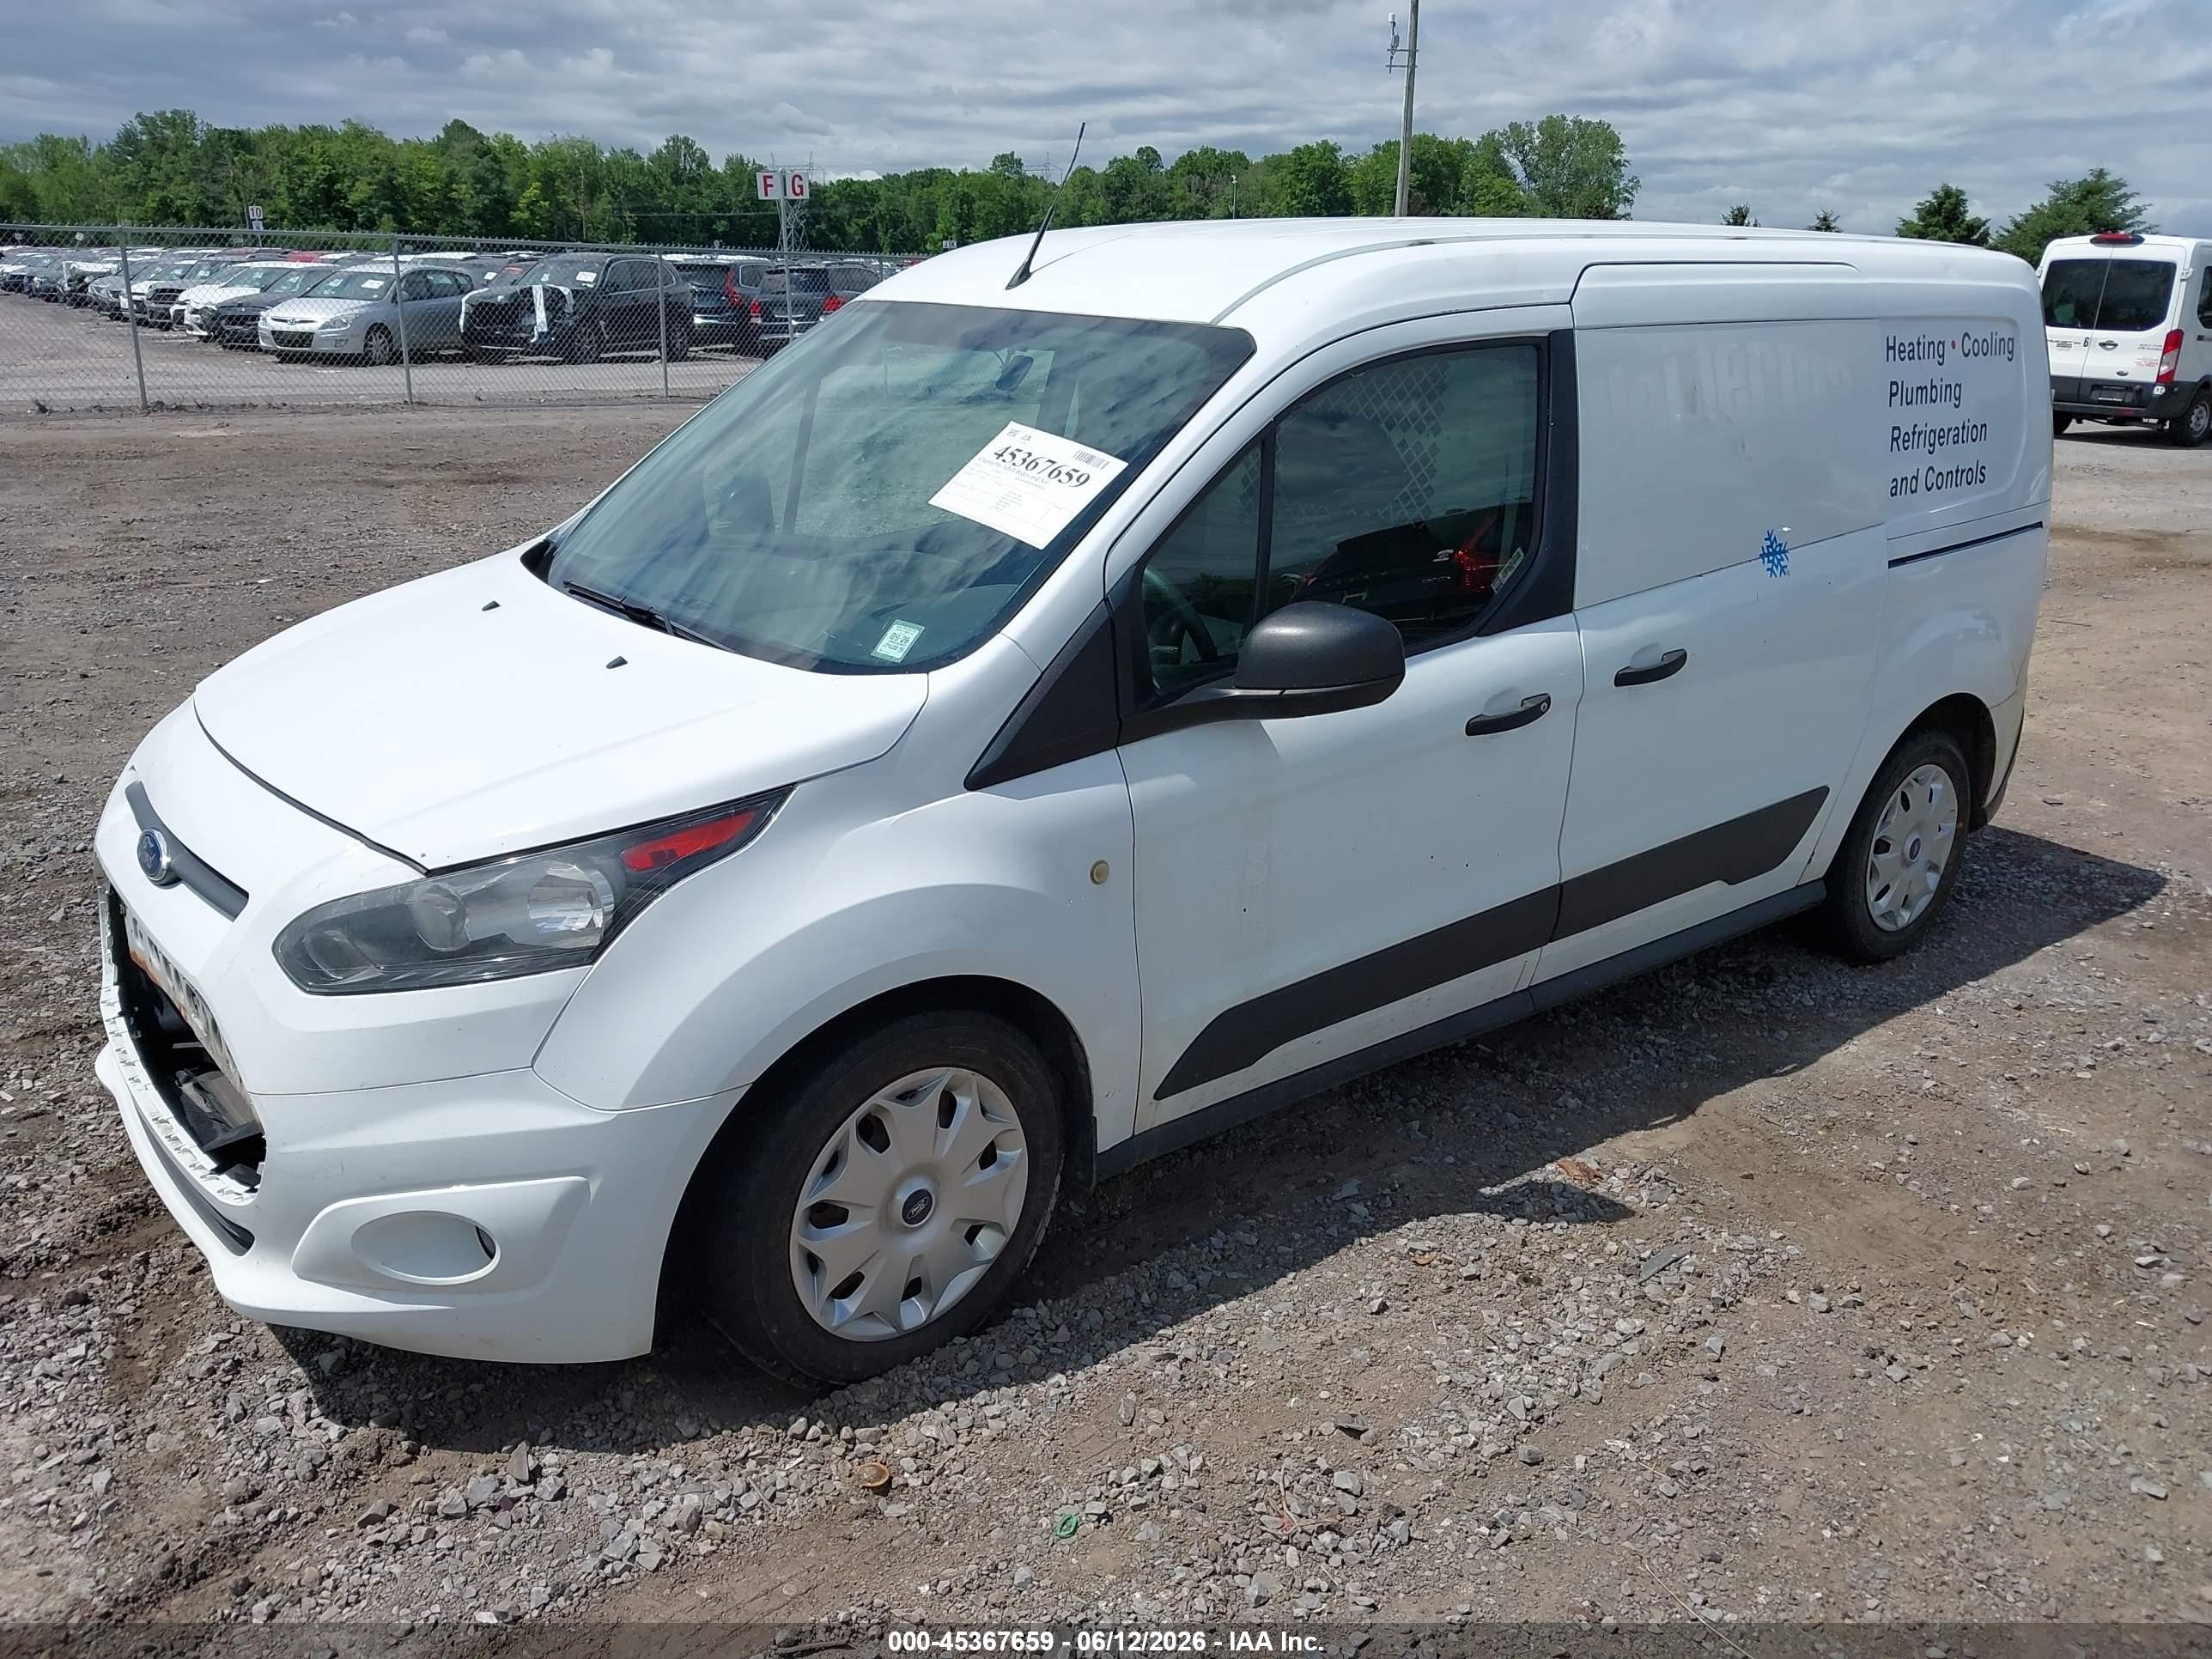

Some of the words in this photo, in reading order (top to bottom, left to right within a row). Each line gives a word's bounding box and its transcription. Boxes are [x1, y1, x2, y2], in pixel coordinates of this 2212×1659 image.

[763, 175, 774, 197] F
[791, 174, 804, 197] G
[251, 207, 262, 218] 10
[1885, 334, 1946, 367] Heating
[1961, 331, 2015, 362] Cooling
[1889, 377, 1963, 409] Plumbing
[1890, 418, 1988, 455] Refrigeration
[994, 446, 1091, 488] 45367659
[1890, 468, 1920, 497] and
[1924, 460, 1987, 493] Controls
